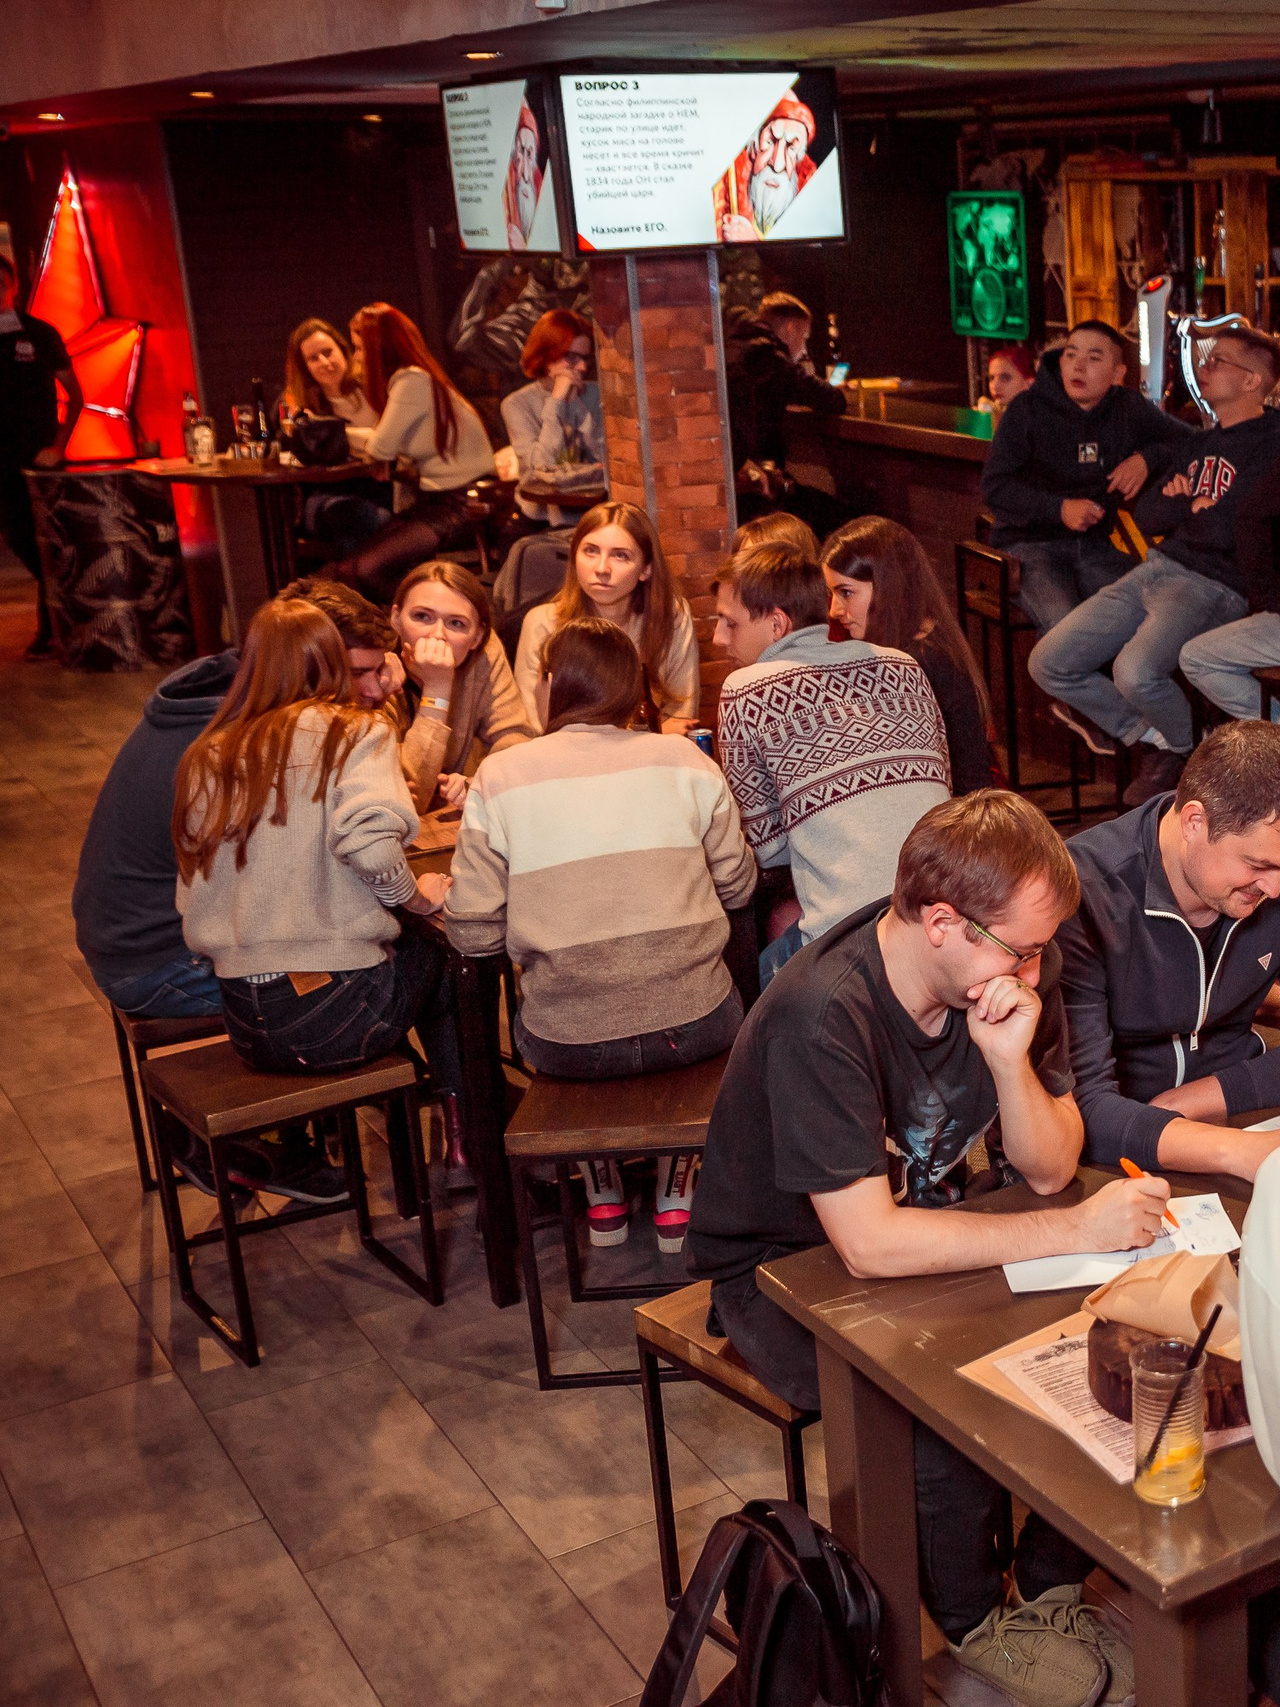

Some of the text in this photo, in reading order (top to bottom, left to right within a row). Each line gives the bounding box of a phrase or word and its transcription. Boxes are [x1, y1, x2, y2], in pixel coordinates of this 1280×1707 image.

[574, 81, 639, 91] ВОПРОС 3
[591, 224, 641, 234] Назовите
